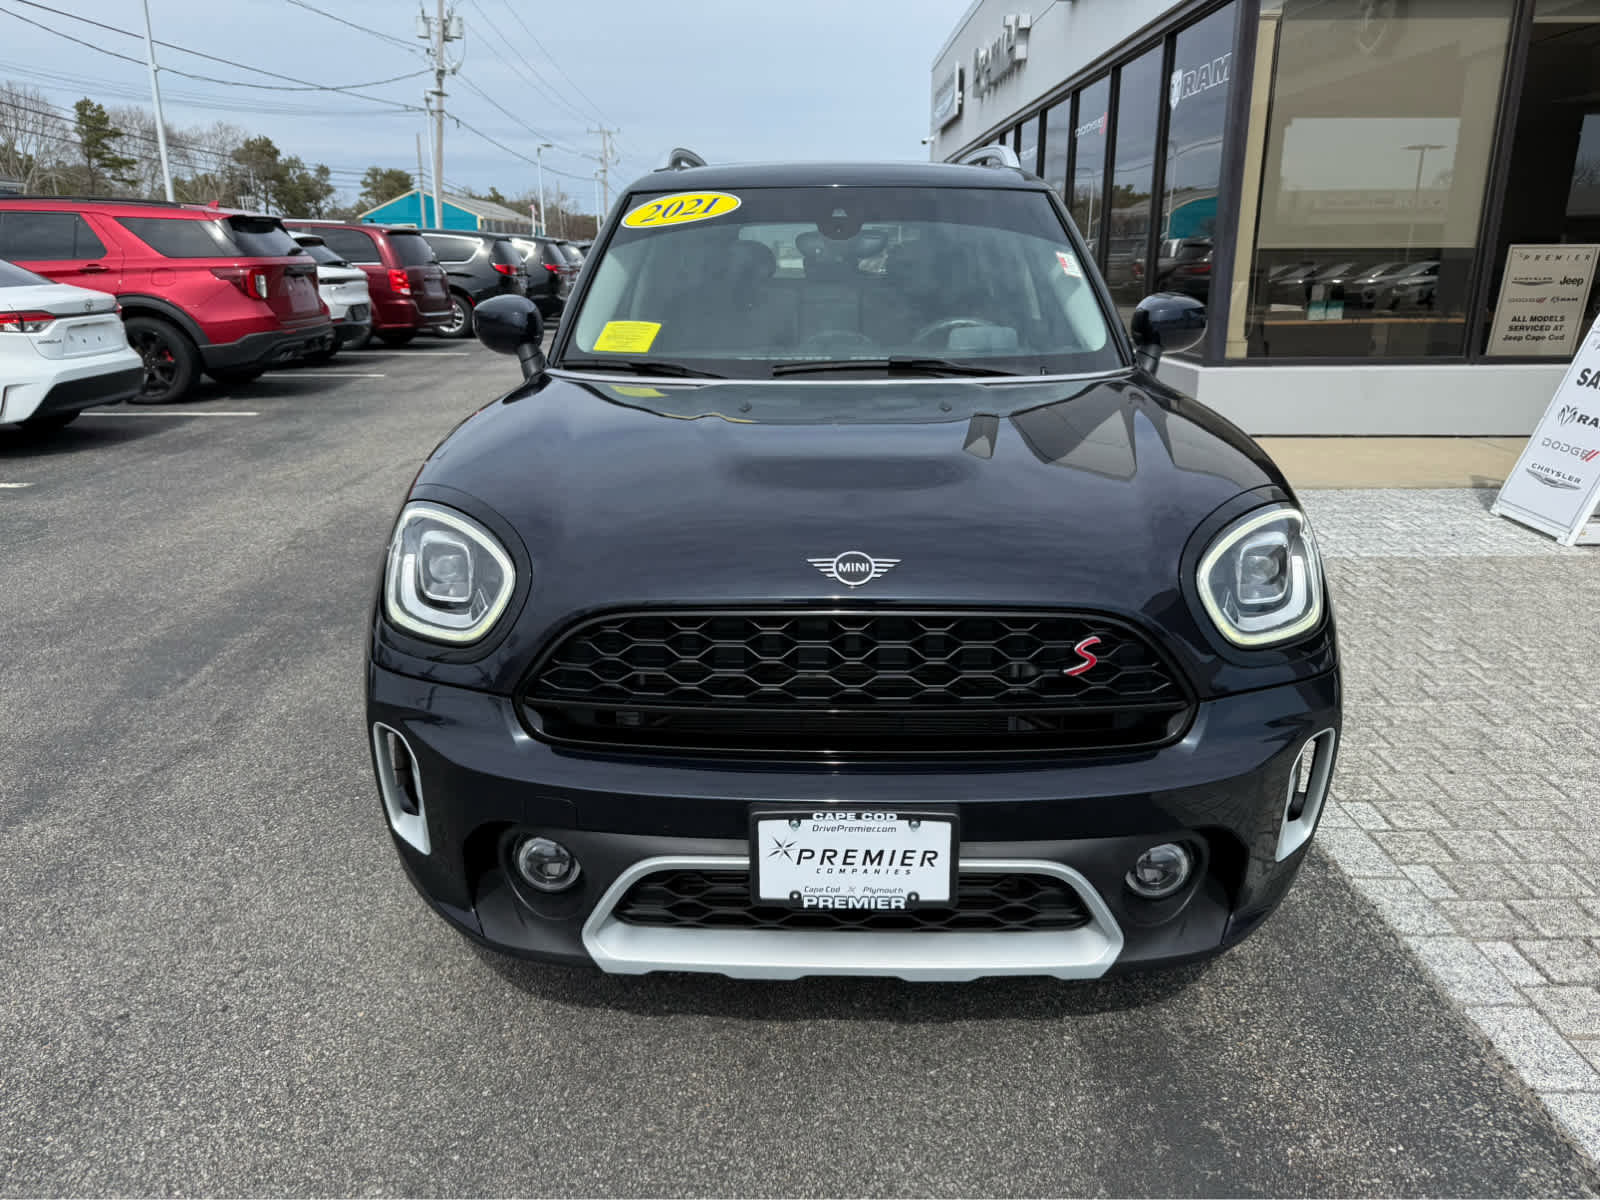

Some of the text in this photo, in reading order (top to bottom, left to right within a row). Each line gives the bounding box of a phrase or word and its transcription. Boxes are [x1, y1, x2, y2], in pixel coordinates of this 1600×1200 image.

[1181, 52, 1233, 99] RAM
[640, 197, 720, 223] 2021
[1560, 276, 1584, 287] Jeep
[1508, 324, 1551, 332] SERVICED
[1576, 367, 1600, 390] SA
[1577, 413, 1600, 429] RA
[1541, 437, 1588, 459] DODGE
[1531, 462, 1582, 484] CHRYSLER
[838, 562, 870, 573] MINI
[1063, 636, 1102, 677] S
[812, 812, 899, 822] CAPE COD
[812, 824, 897, 834] DrivePremier.com
[796, 848, 939, 868] PREMIER
[804, 886, 904, 895] Cape Cod Plymouth
[802, 895, 907, 910] PREMIER
